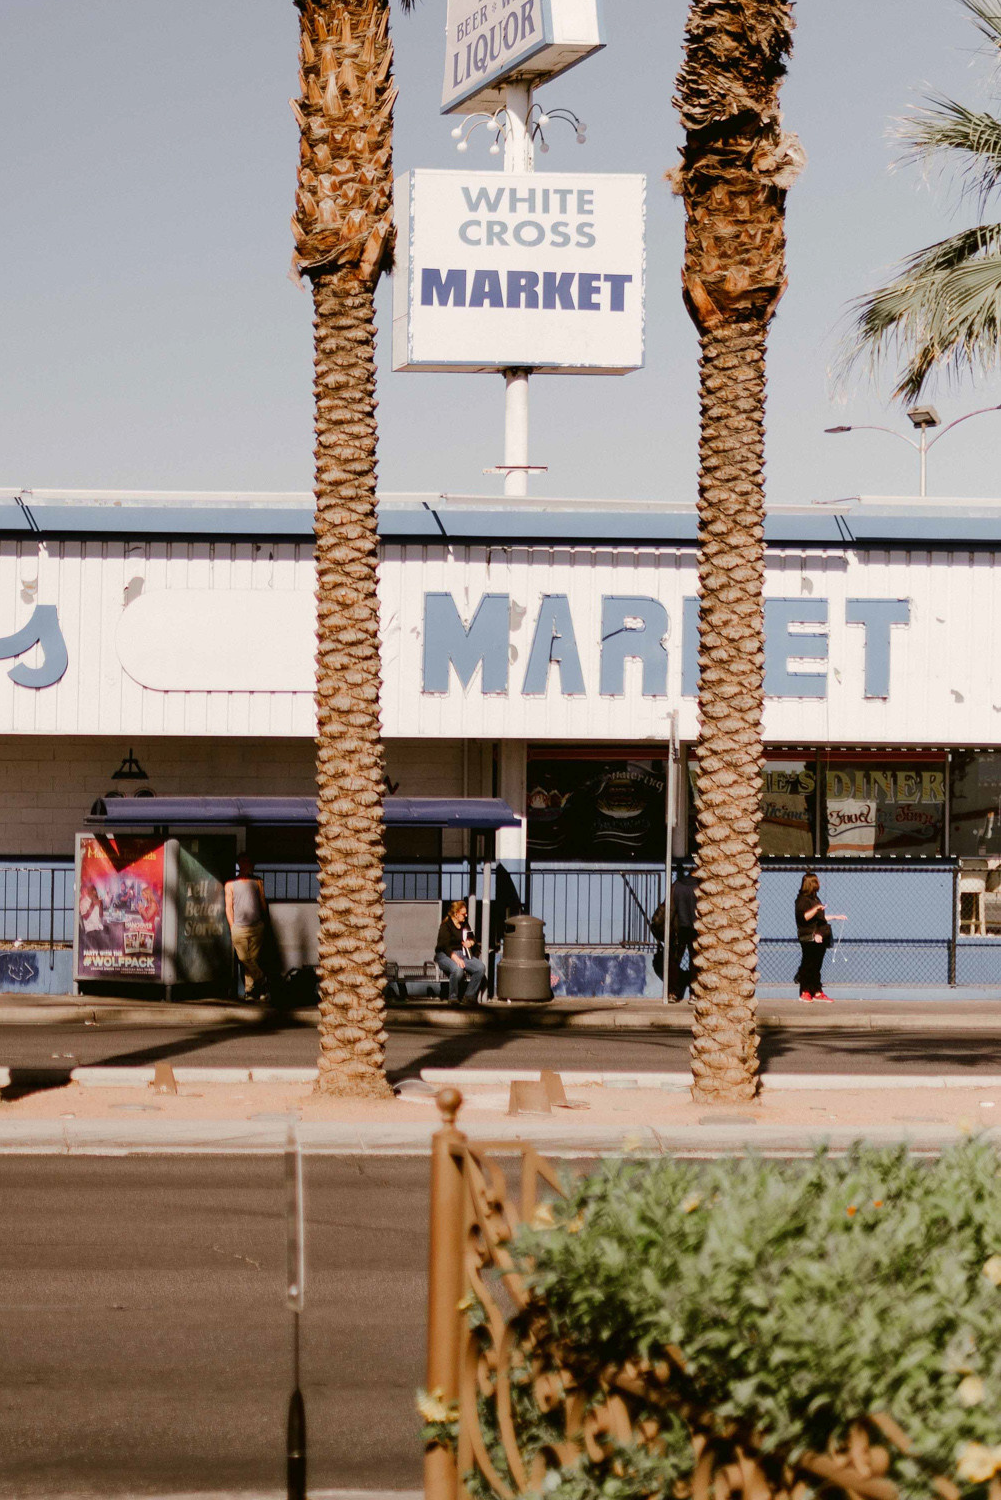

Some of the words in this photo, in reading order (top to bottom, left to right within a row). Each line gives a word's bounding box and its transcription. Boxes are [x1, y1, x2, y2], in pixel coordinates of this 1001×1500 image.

[456, 4, 488, 43] BEER
[460, 186, 594, 215] WHITE
[458, 219, 596, 249] CROSS
[420, 267, 633, 312] MARKET
[421, 591, 911, 702] MARET
[825, 770, 946, 803] DINER
[185, 880, 209, 898] Tell
[184, 899, 221, 918] Better
[184, 920, 223, 937] Stories
[83, 955, 155, 968] #WOLFPACK
